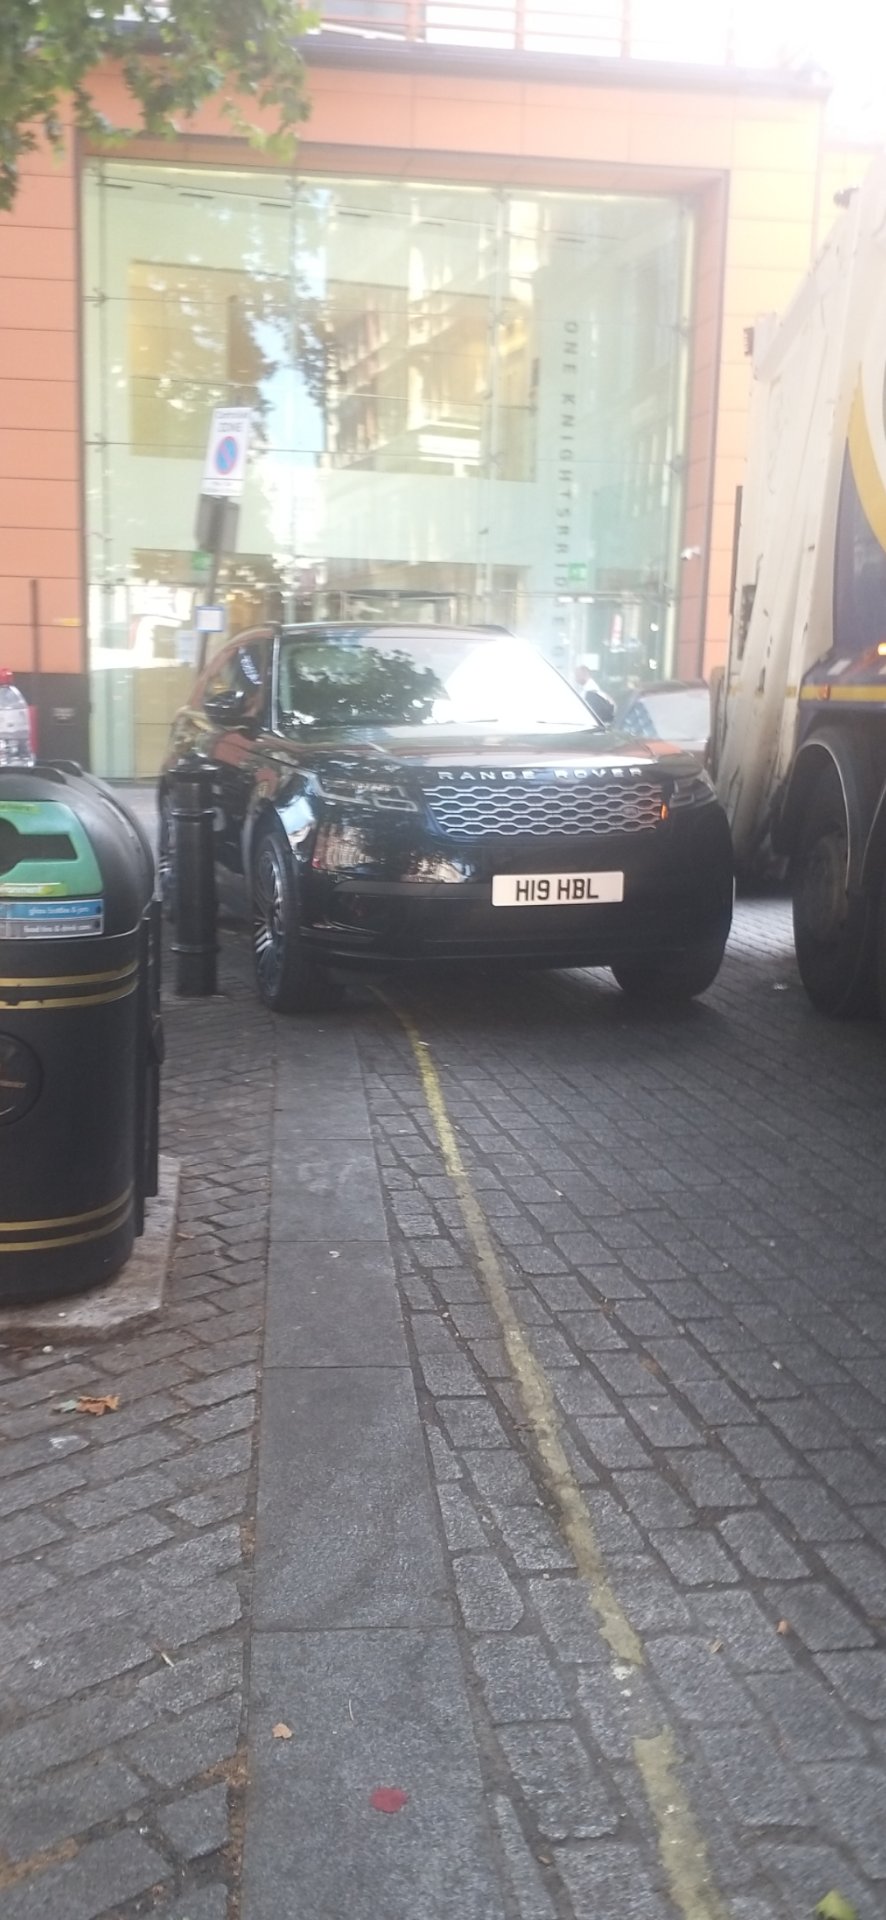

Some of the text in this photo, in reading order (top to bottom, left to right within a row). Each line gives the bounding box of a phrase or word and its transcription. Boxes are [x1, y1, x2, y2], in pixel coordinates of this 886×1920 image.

[562, 320, 579, 374] ONE
[437, 768, 643, 780] RANGE ROVER
[516, 877, 599, 902] H19 HBL
